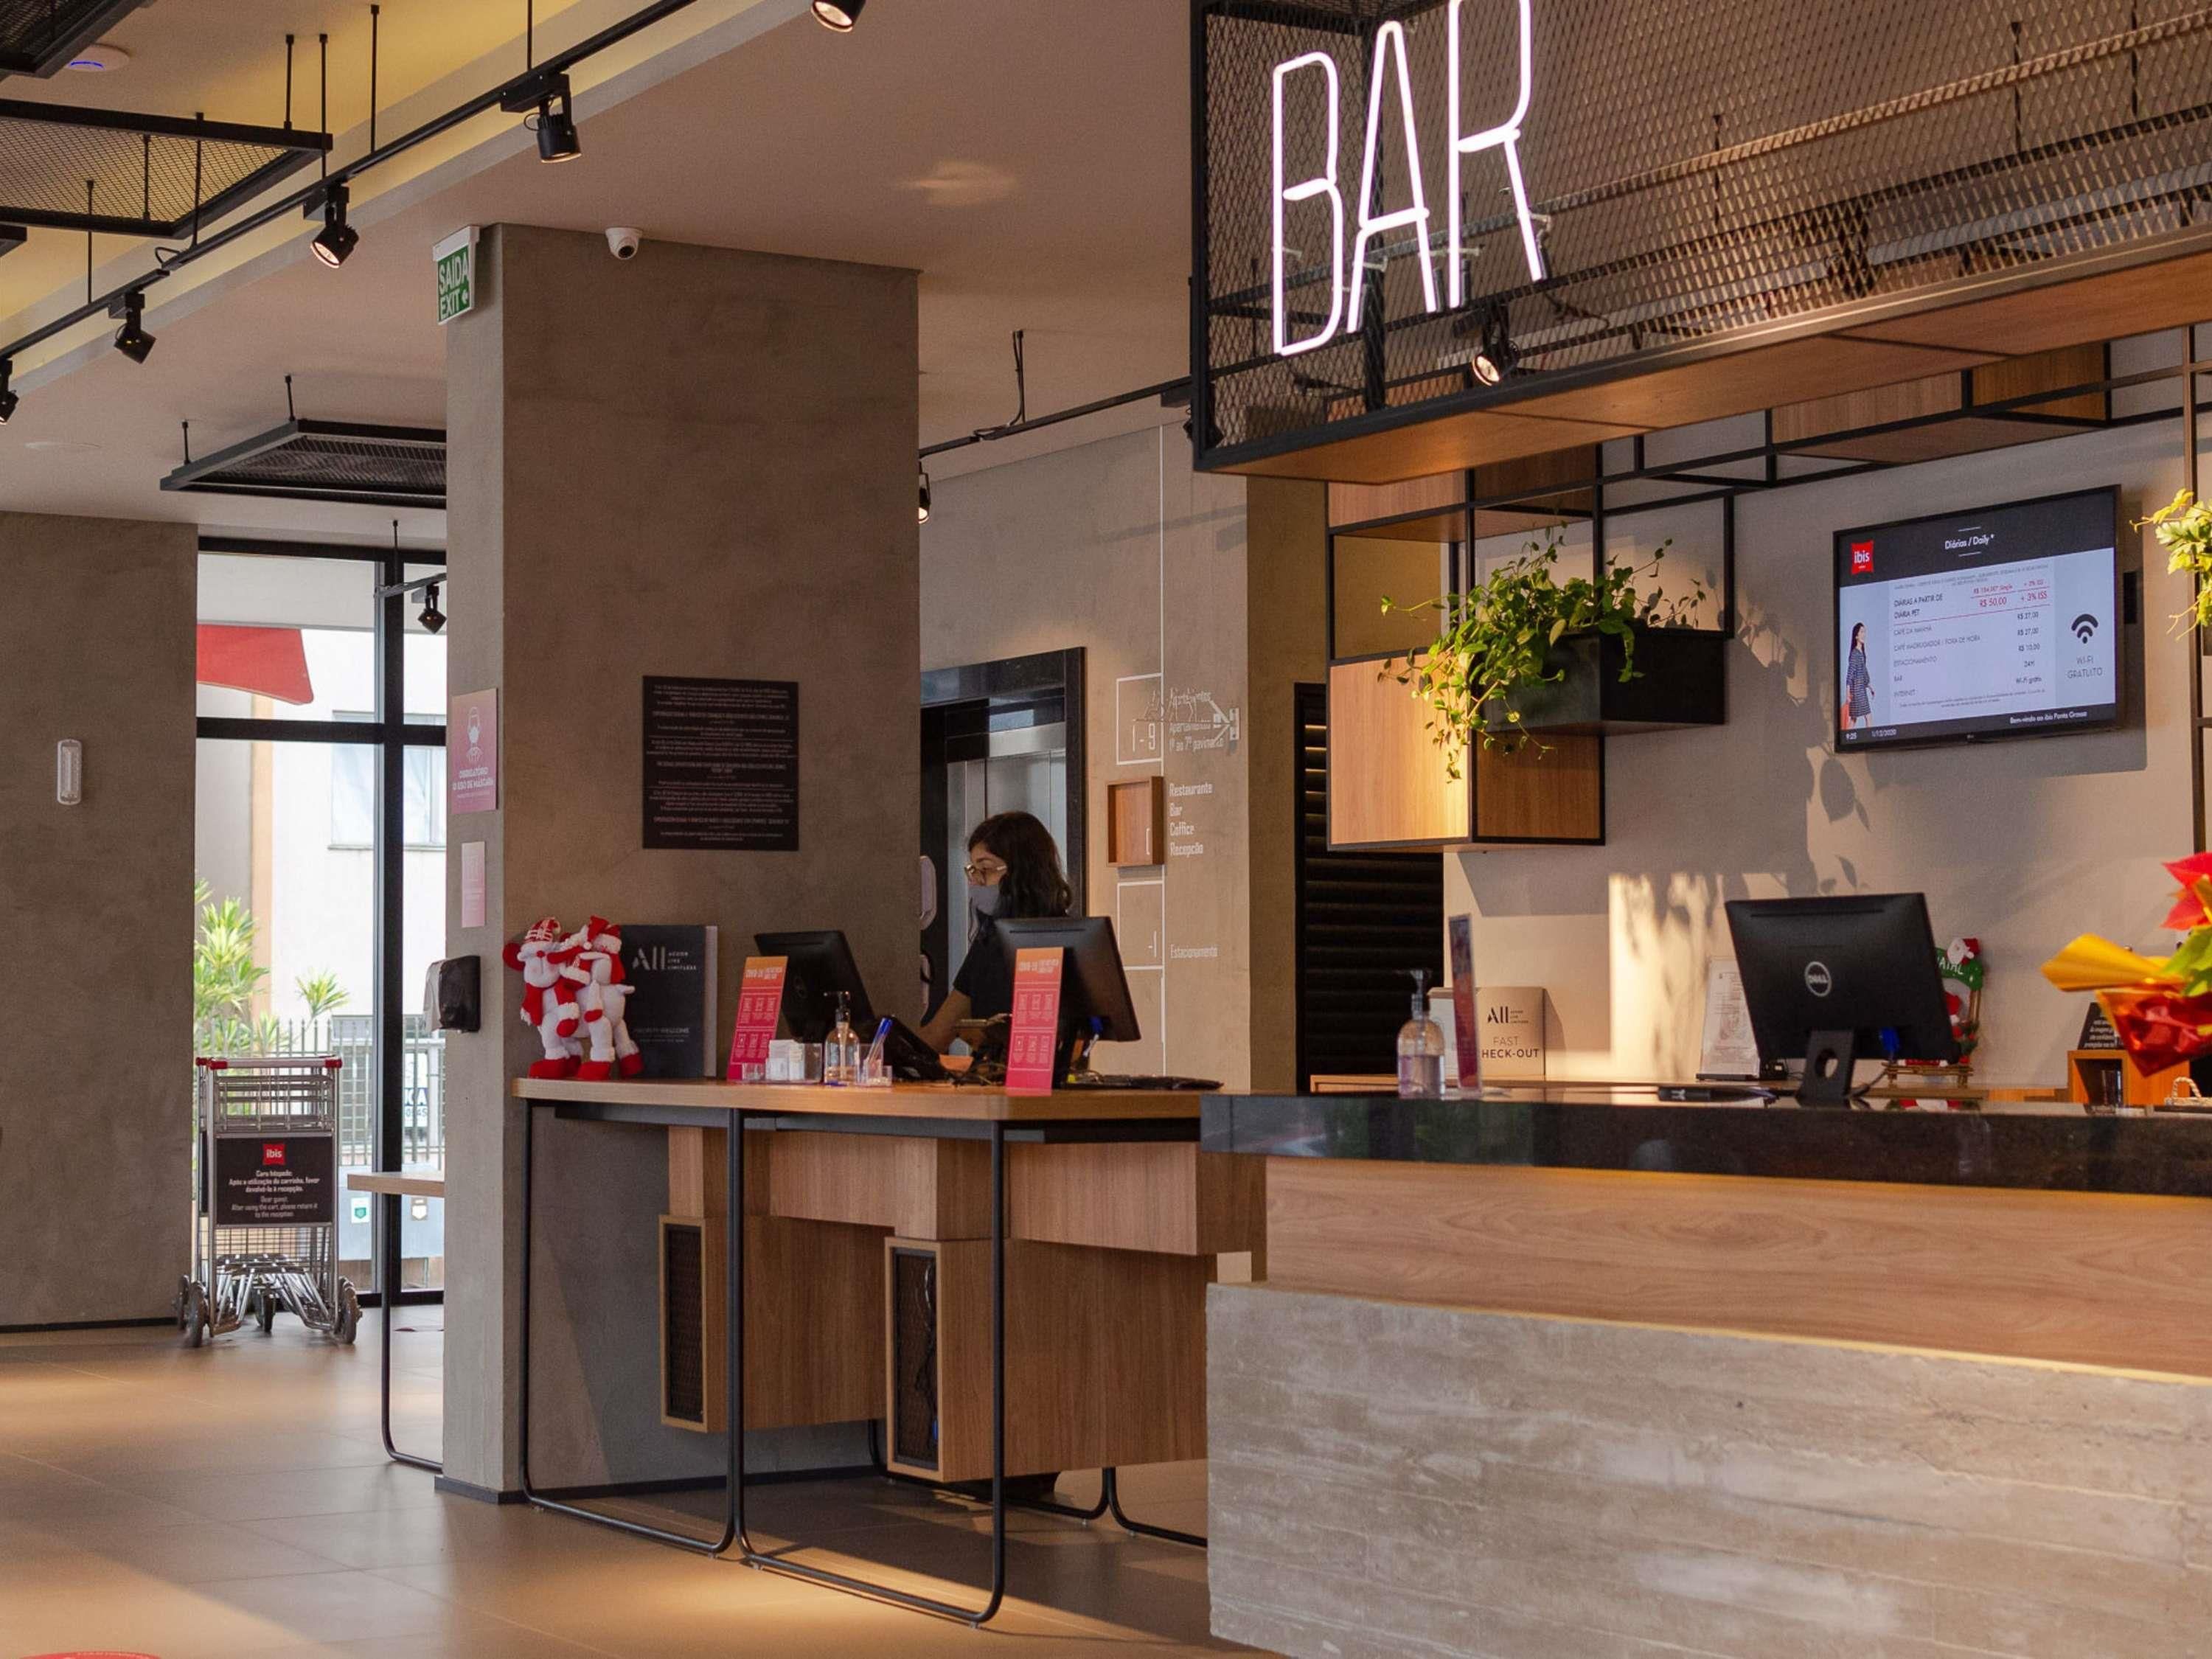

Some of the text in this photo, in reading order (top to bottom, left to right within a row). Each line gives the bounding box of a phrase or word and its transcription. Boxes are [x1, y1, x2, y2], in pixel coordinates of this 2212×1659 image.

[1273, 0, 1546, 356] BAR
[439, 251, 469, 295] SAÍDA
[440, 289, 460, 320] EXIT
[1854, 550, 1870, 563] ibis
[2067, 667, 2103, 679] GRATUITO
[1169, 782, 1213, 797] Restaurante
[1170, 802, 1183, 817] Bar
[1487, 1006, 1509, 1023] All
[1493, 1036, 1520, 1046] FAST
[1481, 1048, 1540, 1058] HECK-OUT
[266, 1149, 283, 1159] ibis
